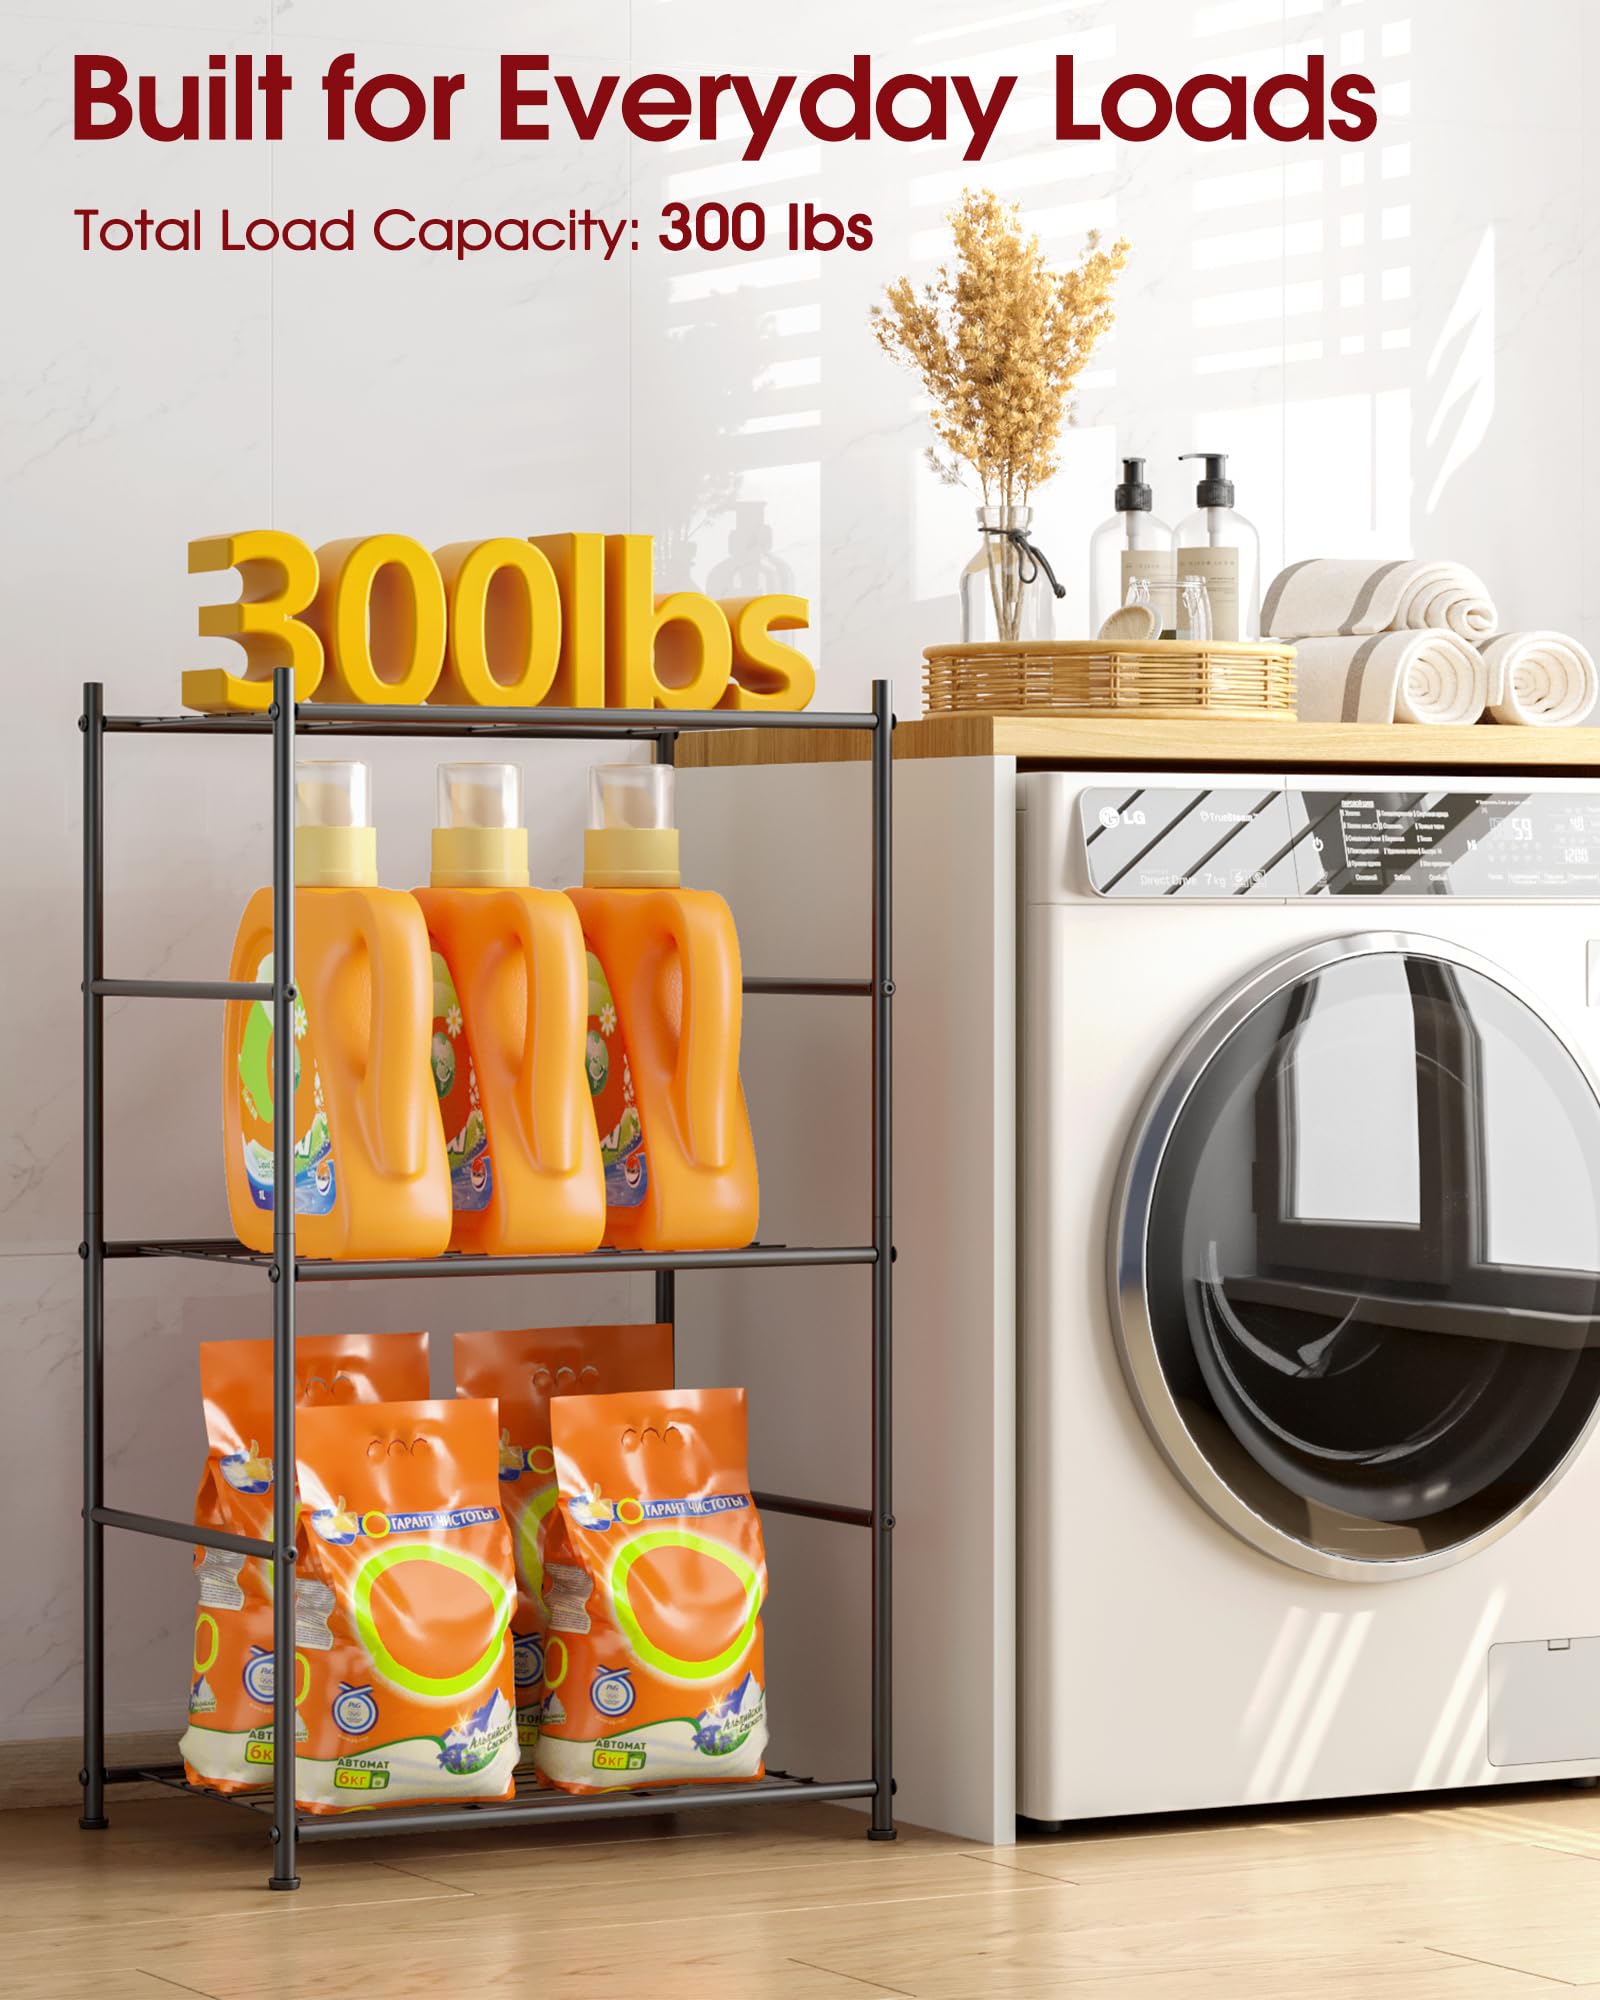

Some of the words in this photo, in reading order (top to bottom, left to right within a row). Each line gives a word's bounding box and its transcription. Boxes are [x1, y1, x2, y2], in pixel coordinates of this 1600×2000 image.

[181, 529, 816, 717] 300lbs
[1123, 810, 1146, 825] LG
[1512, 818, 1533, 840] 59
[644, 1501, 685, 1517] ГАРАНТ
[687, 1495, 745, 1514] ЧИСТОТЫ
[390, 1515, 433, 1531] ГАРАНТ
[435, 1509, 494, 1528] ЧИСТОТЫ
[595, 1739, 647, 1750] АВТОМАТ
[336, 1757, 390, 1769] АВТОМАТ
